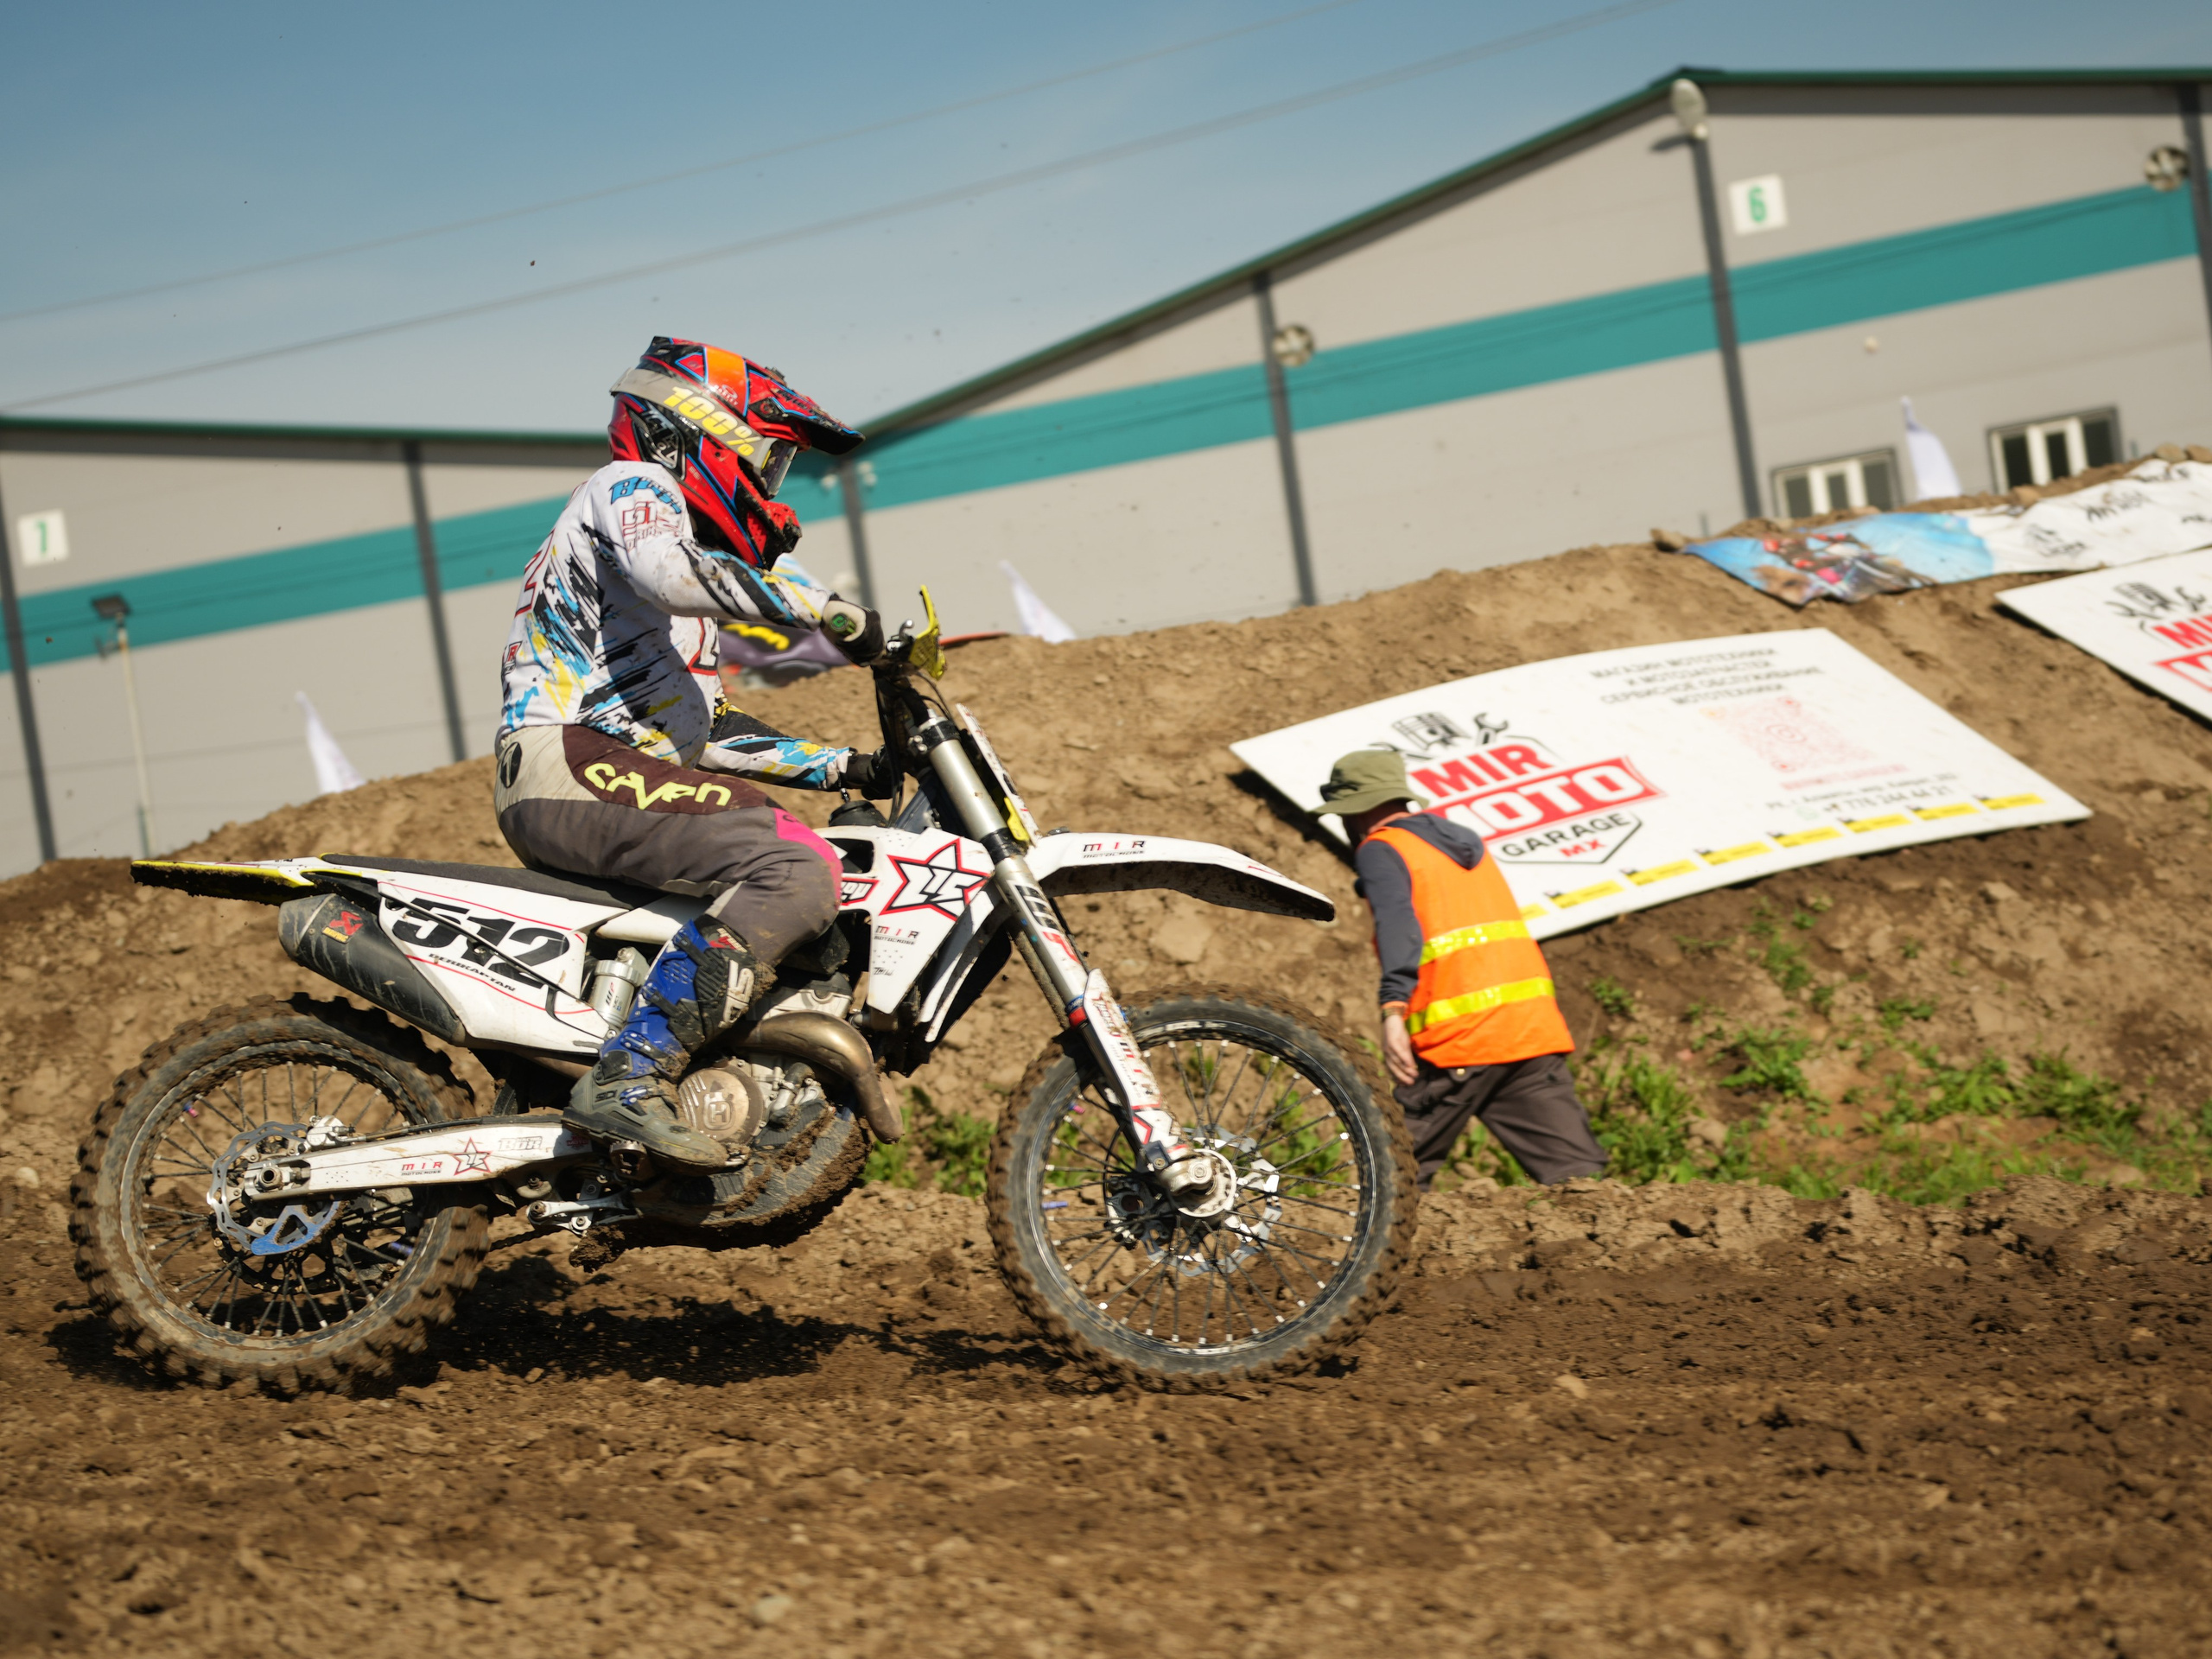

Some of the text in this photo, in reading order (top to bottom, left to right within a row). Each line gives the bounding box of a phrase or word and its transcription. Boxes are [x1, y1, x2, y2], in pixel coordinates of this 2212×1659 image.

[1747, 186, 1768, 224] 6
[663, 386, 762, 456] 100%
[2152, 614, 2212, 649] MI
[1408, 744, 1554, 798] MIR
[1083, 839, 1146, 852] MIR
[1502, 811, 1630, 857] GARAGE
[1559, 838, 1605, 857] MX
[391, 897, 570, 989] 512
[875, 925, 920, 939] MIR
[402, 1161, 443, 1172] MIR
